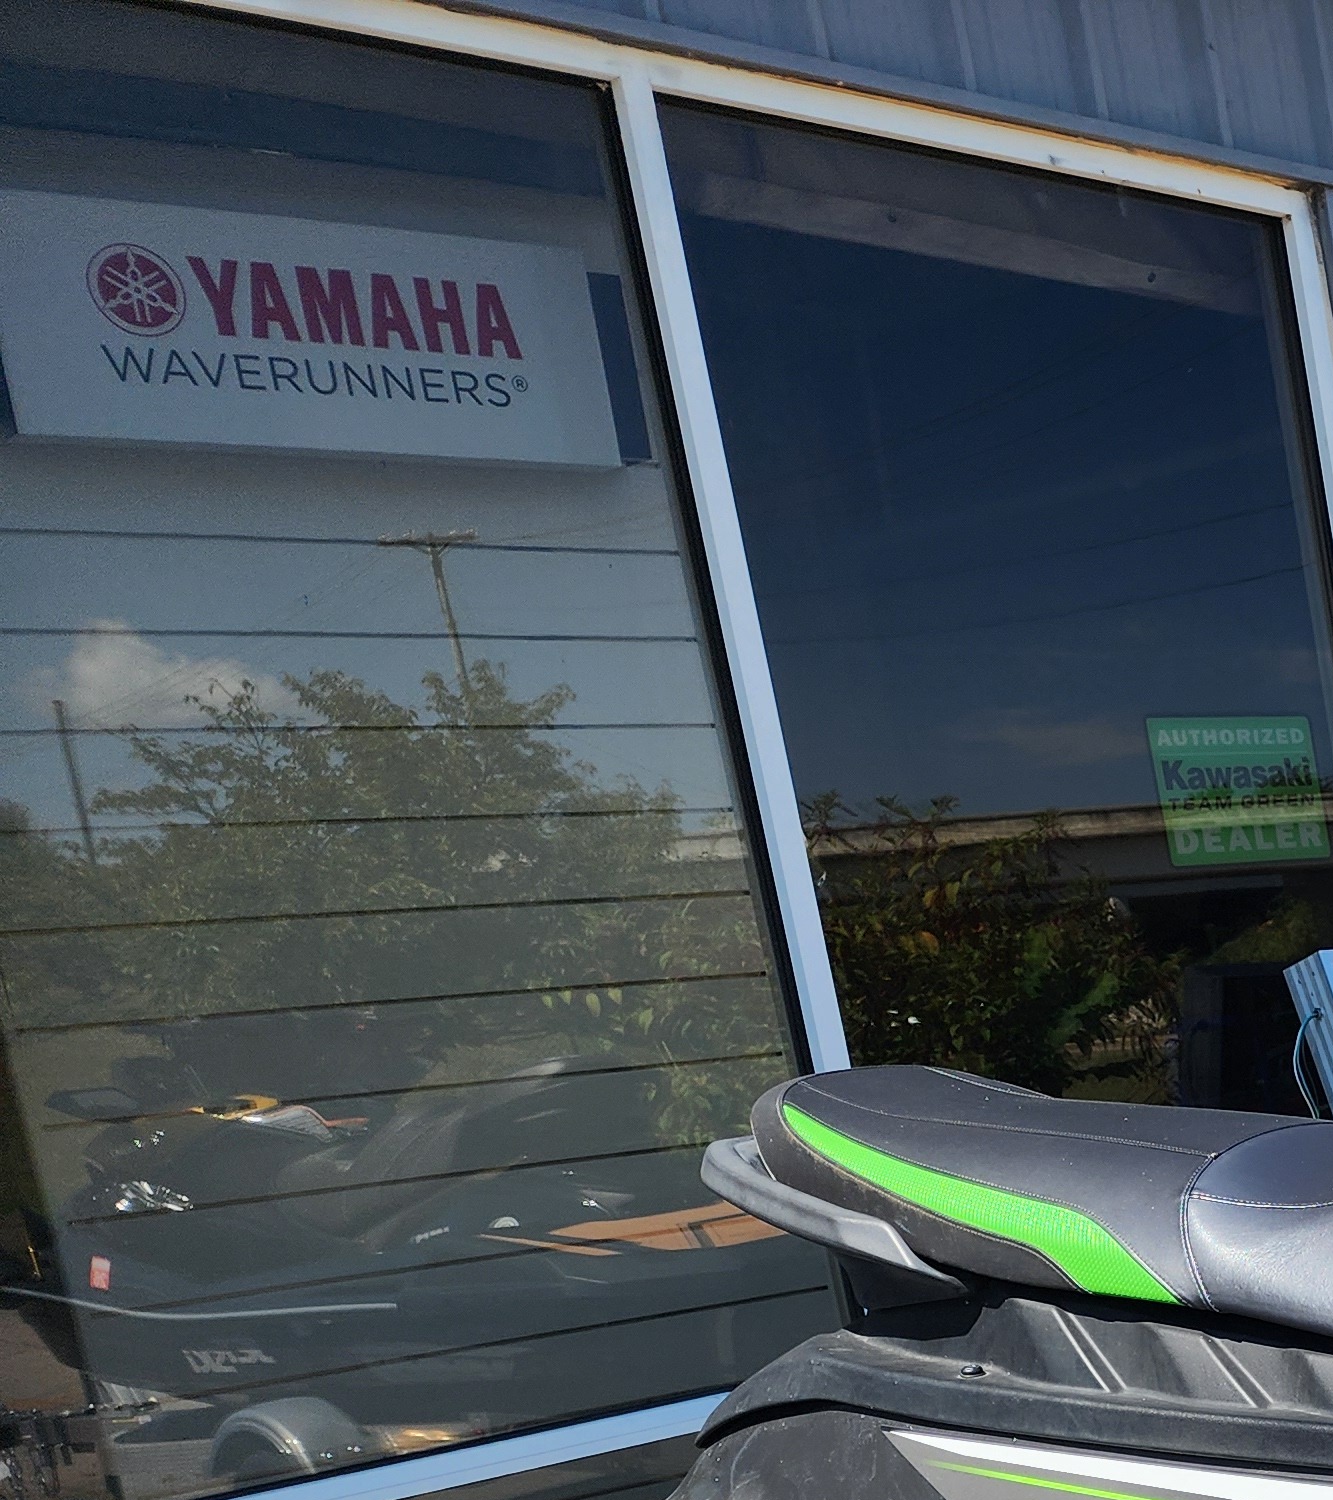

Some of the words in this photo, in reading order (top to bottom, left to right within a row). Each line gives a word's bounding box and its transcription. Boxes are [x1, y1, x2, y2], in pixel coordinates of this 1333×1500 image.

[185, 256, 523, 360] YAMAHA
[1157, 728, 1305, 747] AUTHORIZED
[1161, 757, 1313, 791] Kawasaki
[1168, 795, 1232, 812] TEAM
[1241, 792, 1315, 809] GREEN
[1173, 821, 1323, 855] DEALER
